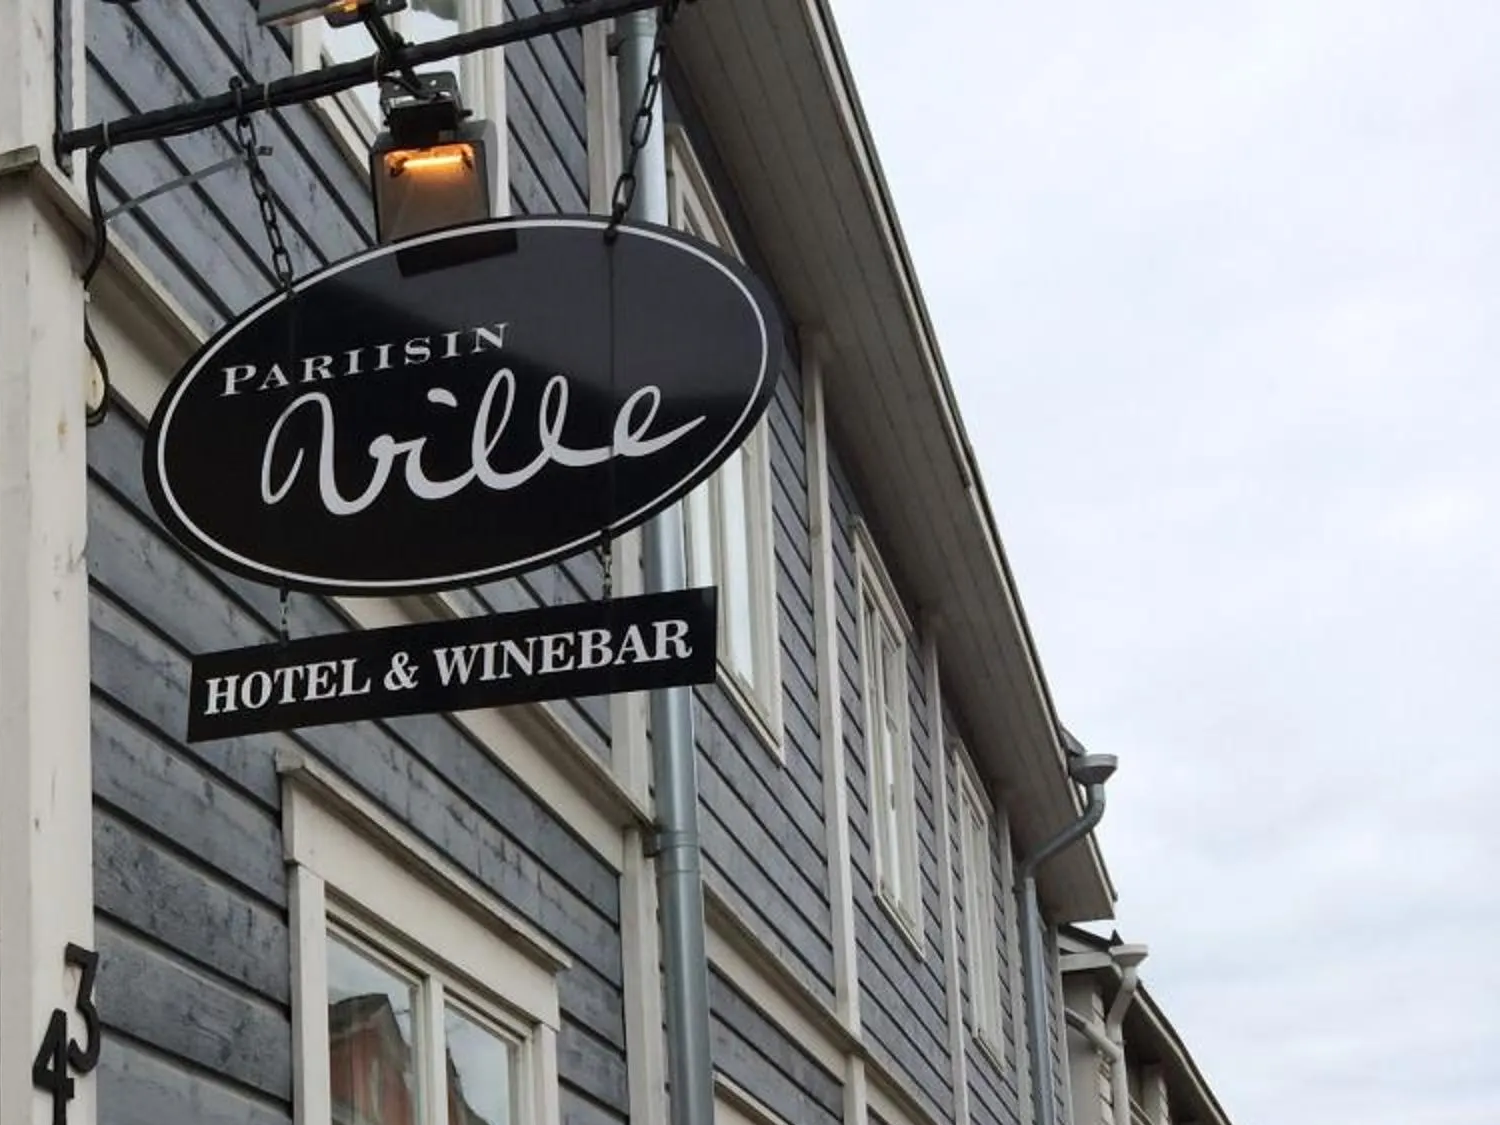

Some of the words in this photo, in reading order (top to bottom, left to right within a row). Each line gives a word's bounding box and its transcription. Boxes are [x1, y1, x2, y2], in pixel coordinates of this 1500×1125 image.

[220, 322, 511, 398] PARIISIN
[261, 367, 706, 516] Ville
[203, 657, 371, 716] HOTEL
[383, 651, 420, 691] &
[432, 618, 693, 687] WINEBAR
